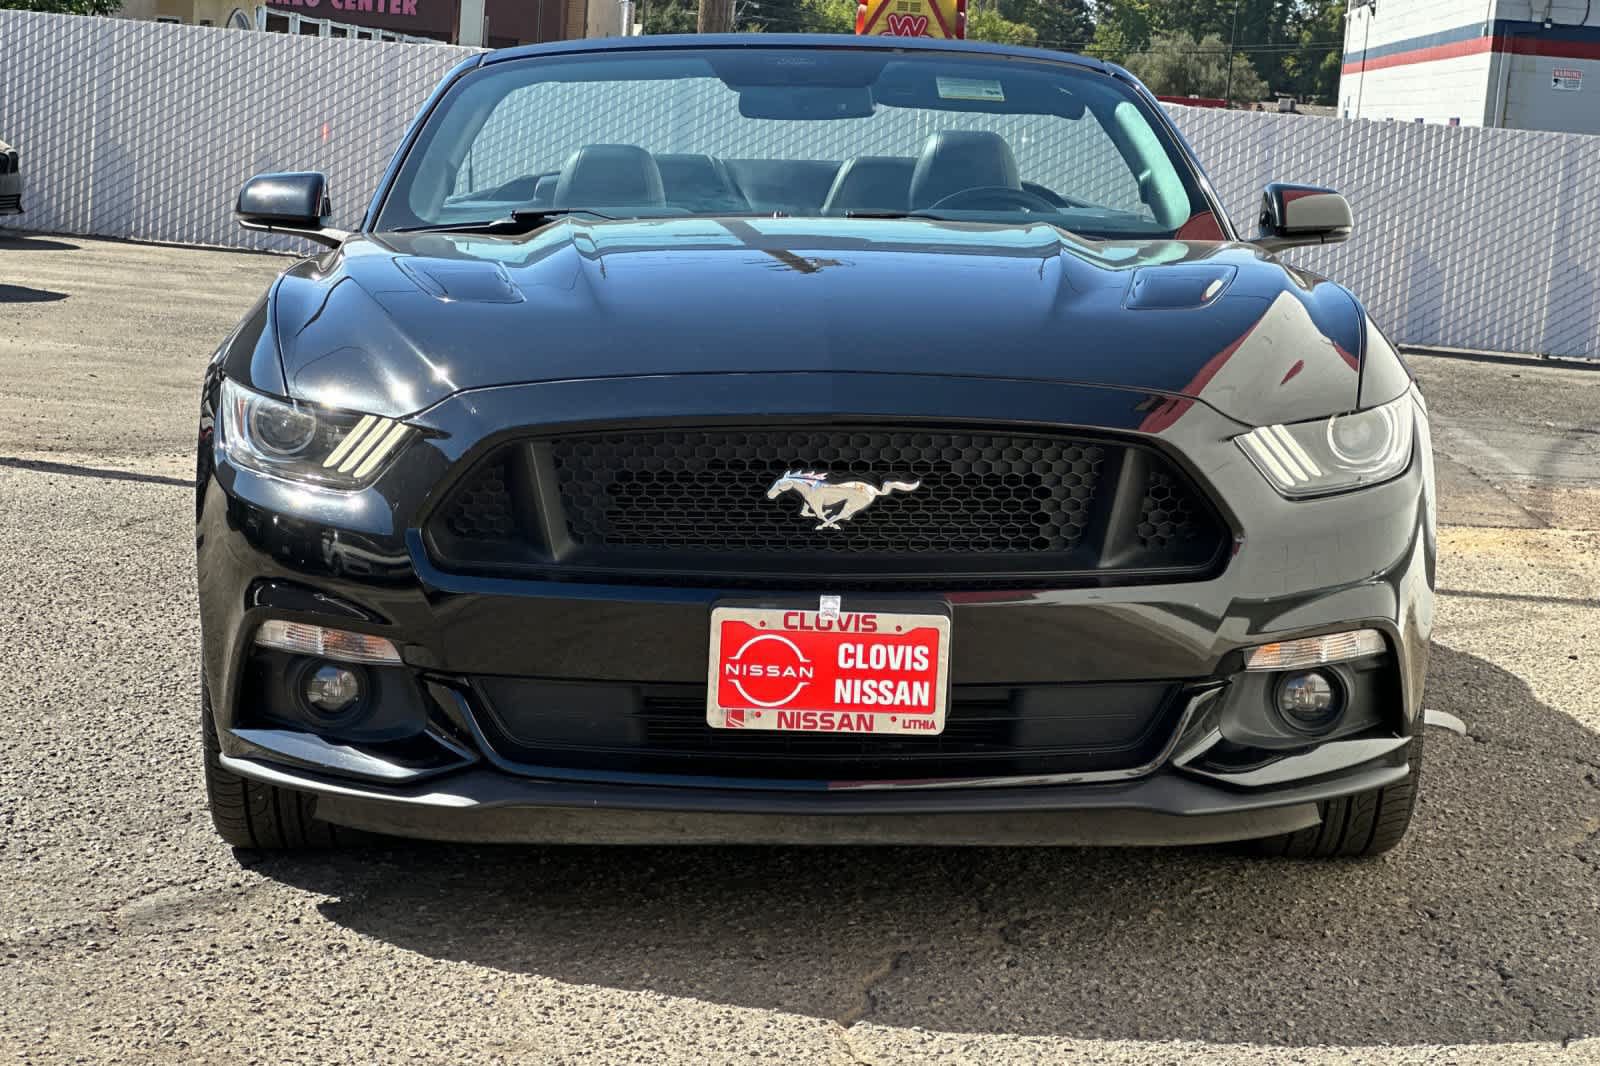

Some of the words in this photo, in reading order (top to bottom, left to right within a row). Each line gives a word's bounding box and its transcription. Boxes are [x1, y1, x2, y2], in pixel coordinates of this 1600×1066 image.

[888, 13, 928, 37] W
[783, 611, 877, 632] CLOVIS
[838, 643, 929, 671] CLOVIS
[725, 663, 814, 678] NISSAN
[834, 679, 929, 706] NISSAN
[777, 711, 874, 731] NISSAN
[902, 719, 936, 730] LITHIA
